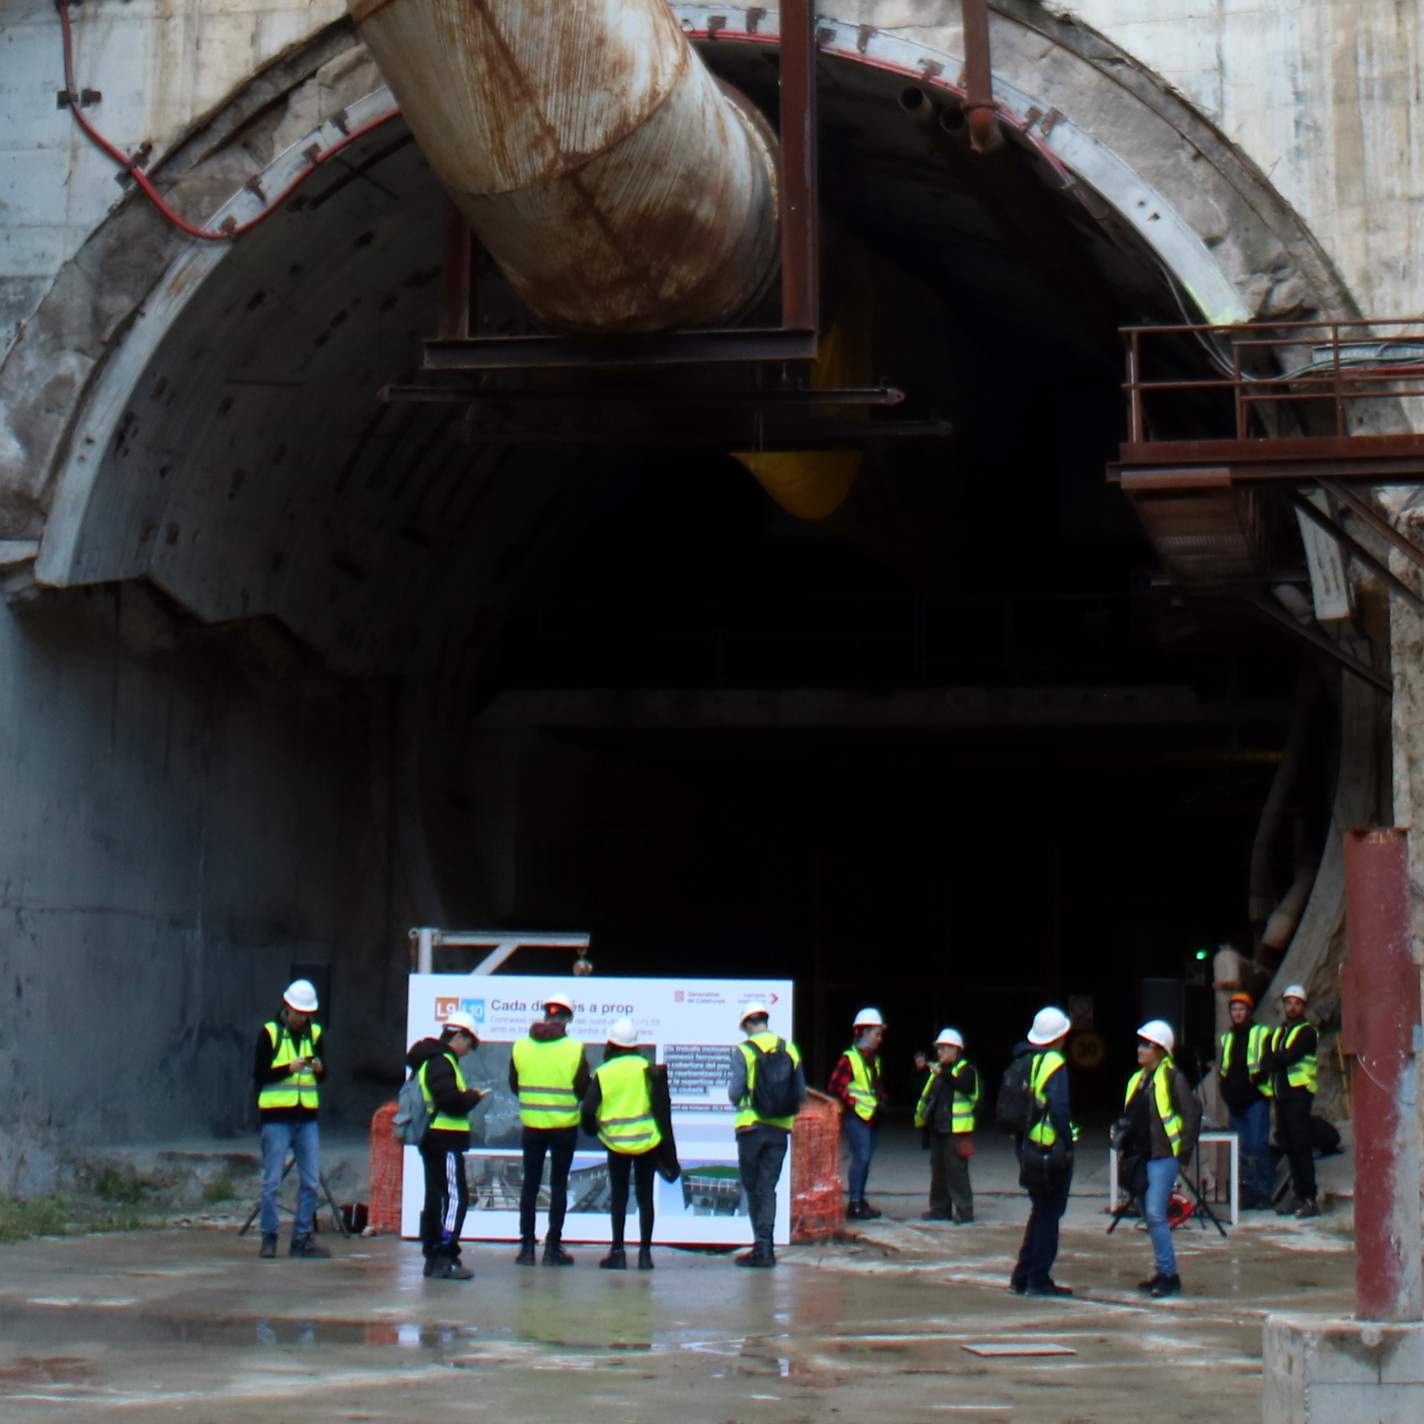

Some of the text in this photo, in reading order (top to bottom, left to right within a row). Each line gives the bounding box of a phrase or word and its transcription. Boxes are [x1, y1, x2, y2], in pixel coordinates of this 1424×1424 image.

[491, 999, 526, 1012] Cada
[589, 1003, 597, 1013] a
[602, 1002, 634, 1015] prop
